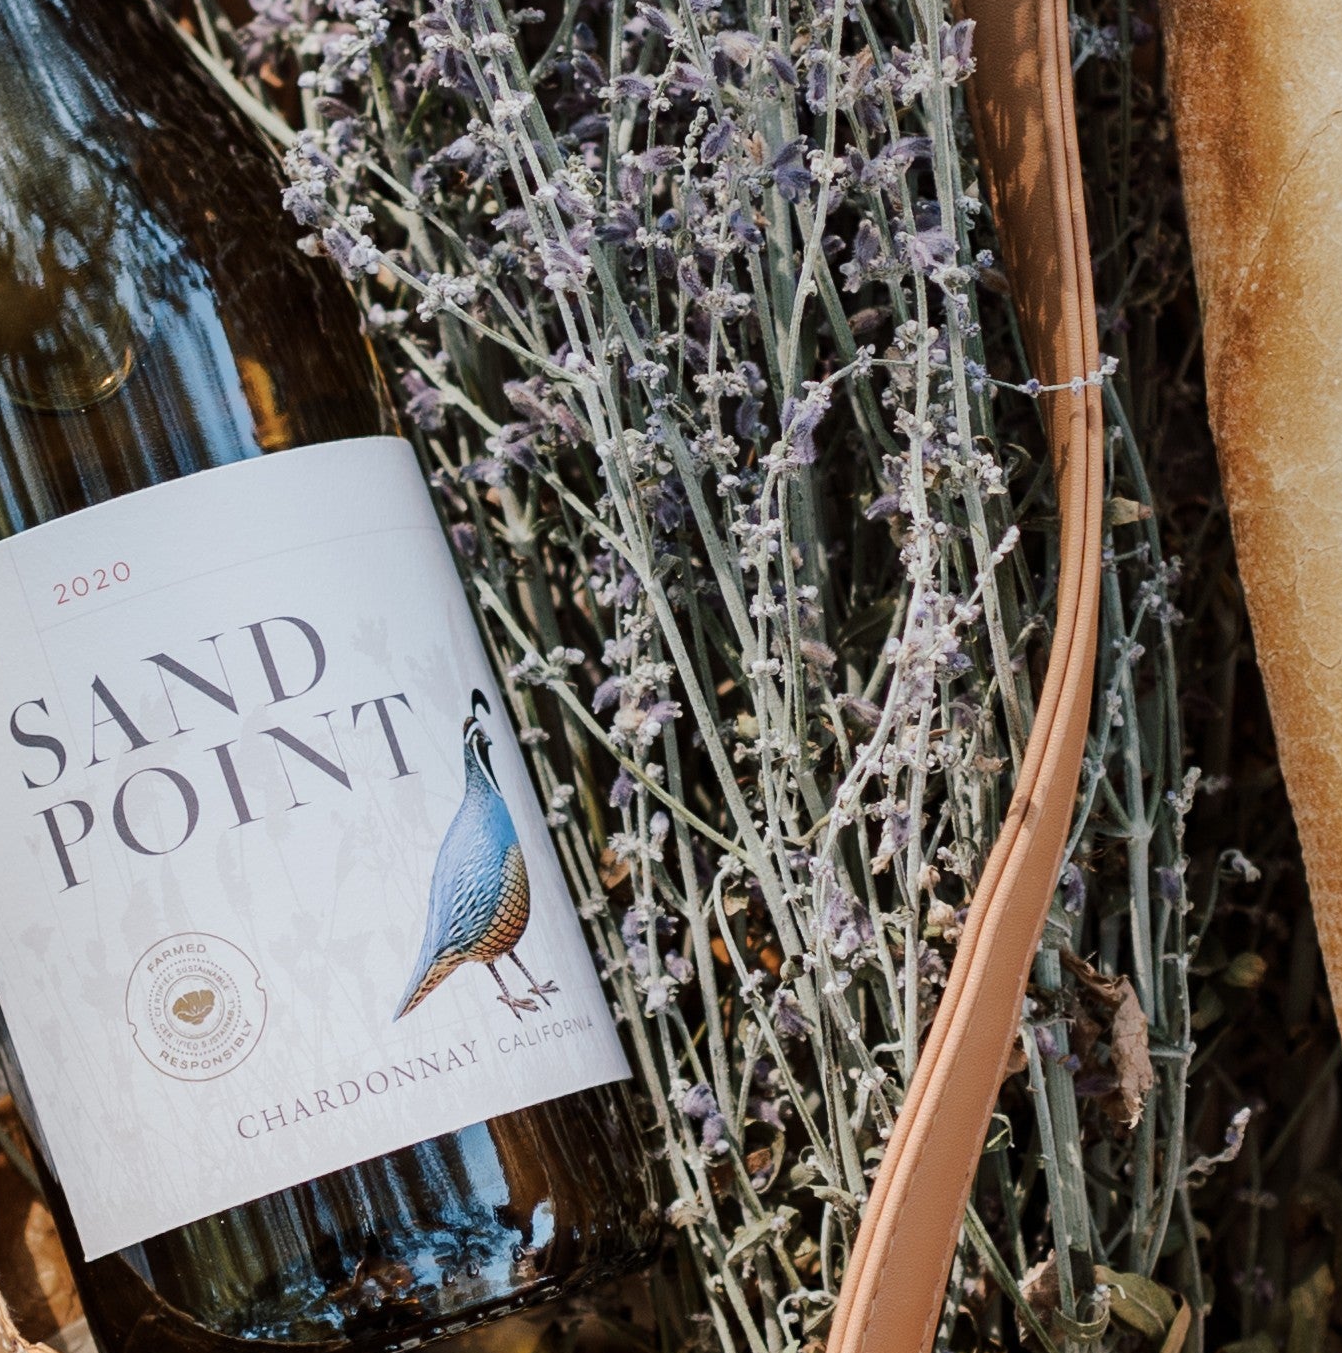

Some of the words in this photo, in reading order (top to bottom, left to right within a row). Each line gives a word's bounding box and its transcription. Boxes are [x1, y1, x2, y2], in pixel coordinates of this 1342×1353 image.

[52, 561, 131, 605] 2020
[10, 616, 326, 789] SAND
[33, 692, 419, 893] POINT
[147, 943, 206, 973] FARMED
[159, 1019, 252, 1070] RESPONSIBLY
[237, 1039, 479, 1139] CHARDONNAY
[497, 1015, 594, 1054] CALIFORNIA
